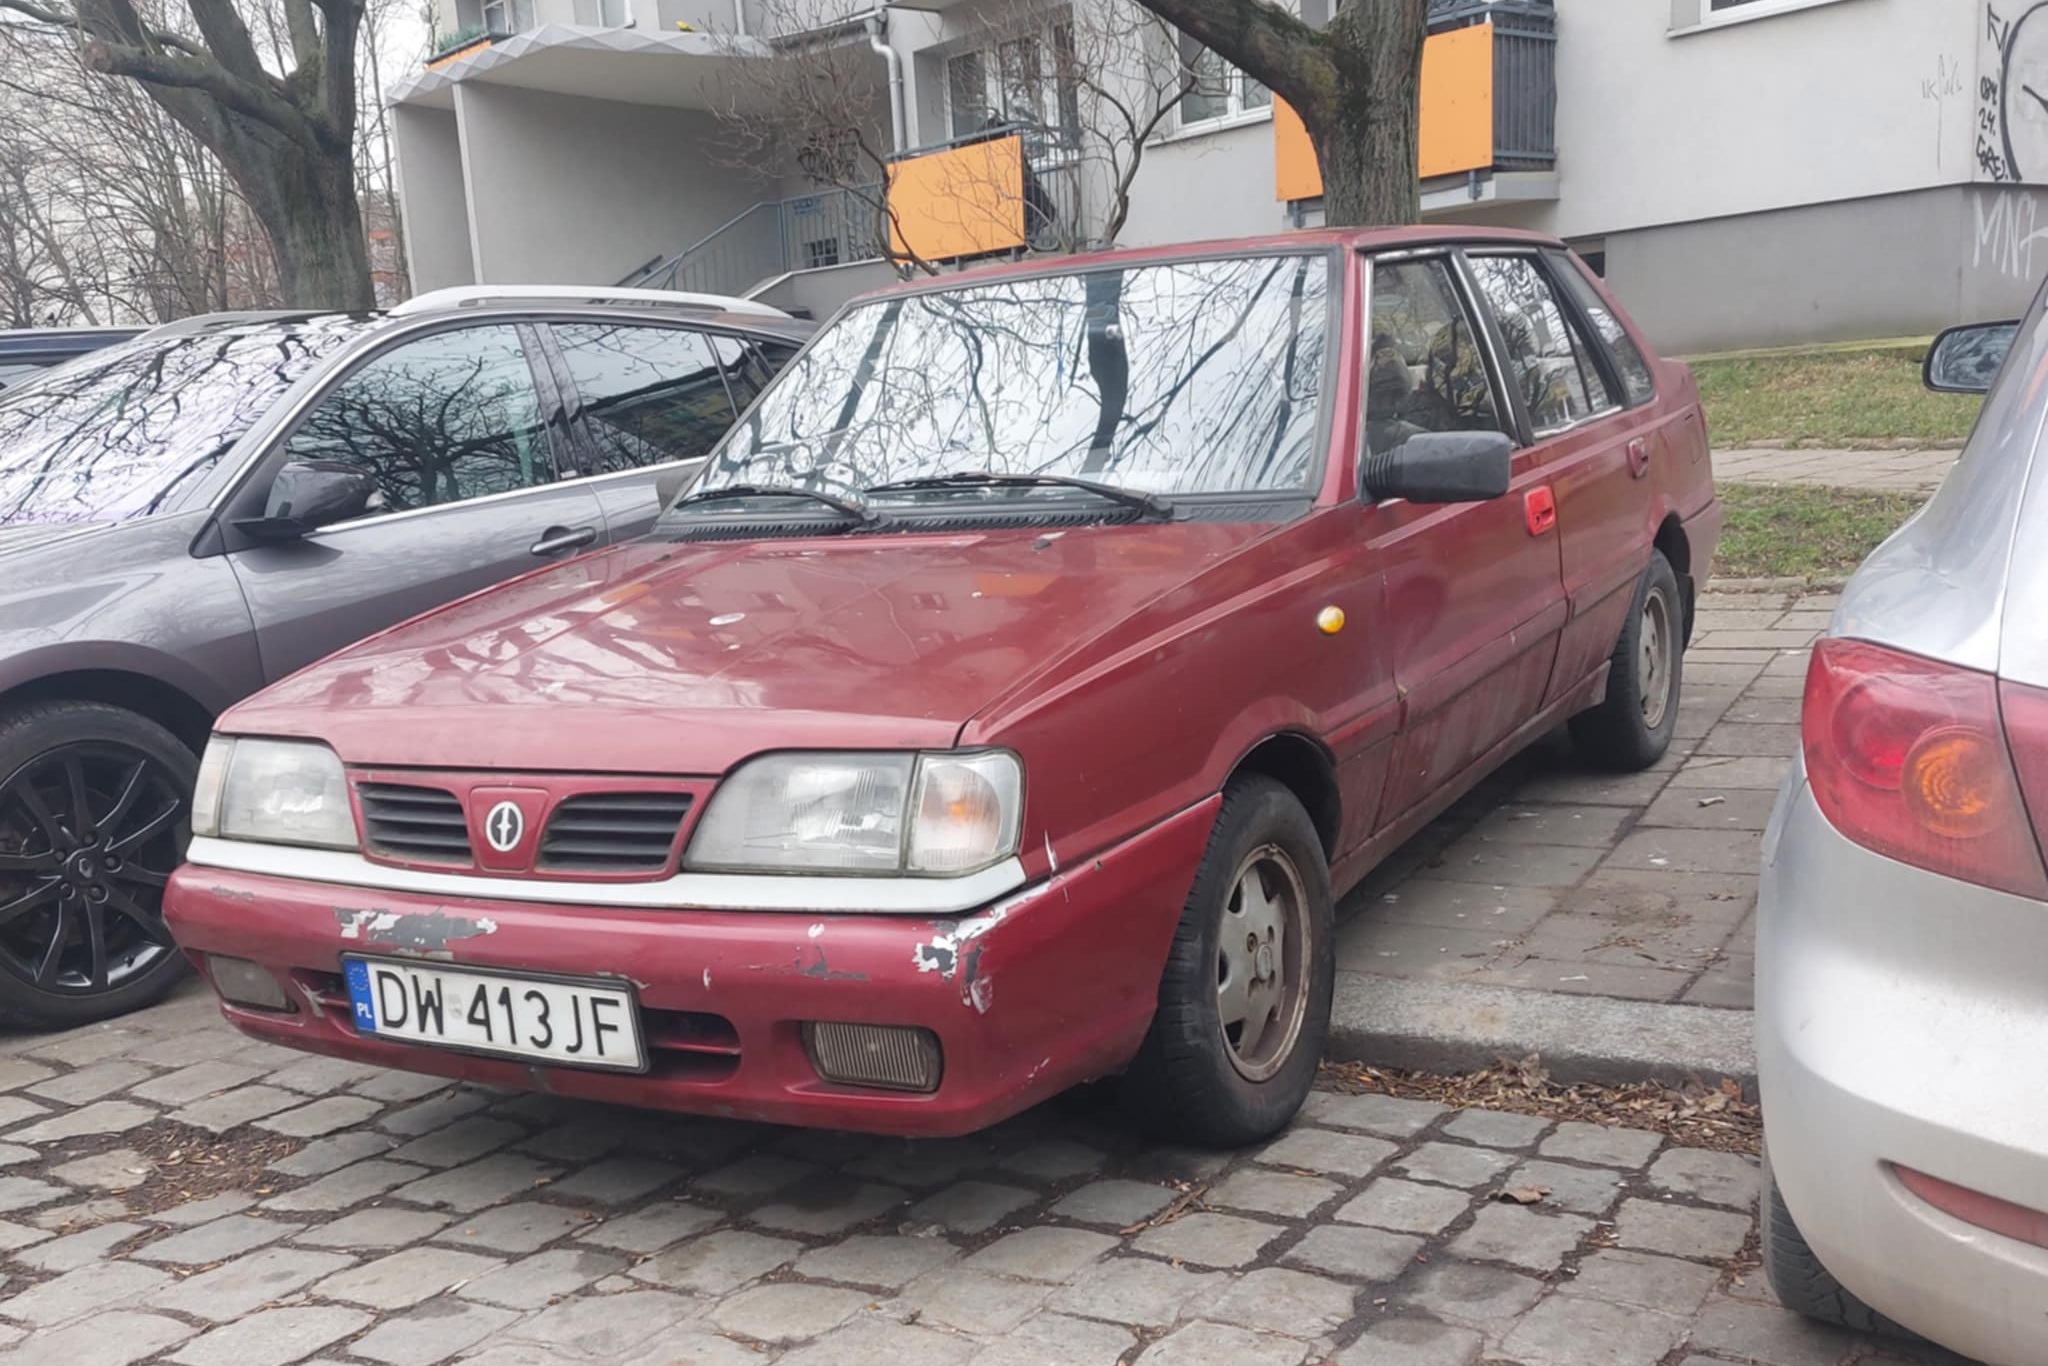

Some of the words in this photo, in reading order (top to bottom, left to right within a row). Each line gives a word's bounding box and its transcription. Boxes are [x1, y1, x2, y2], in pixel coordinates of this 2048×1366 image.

[356, 1002, 373, 1019] PL
[376, 970, 444, 1035] DW
[467, 983, 620, 1056] 413JF
